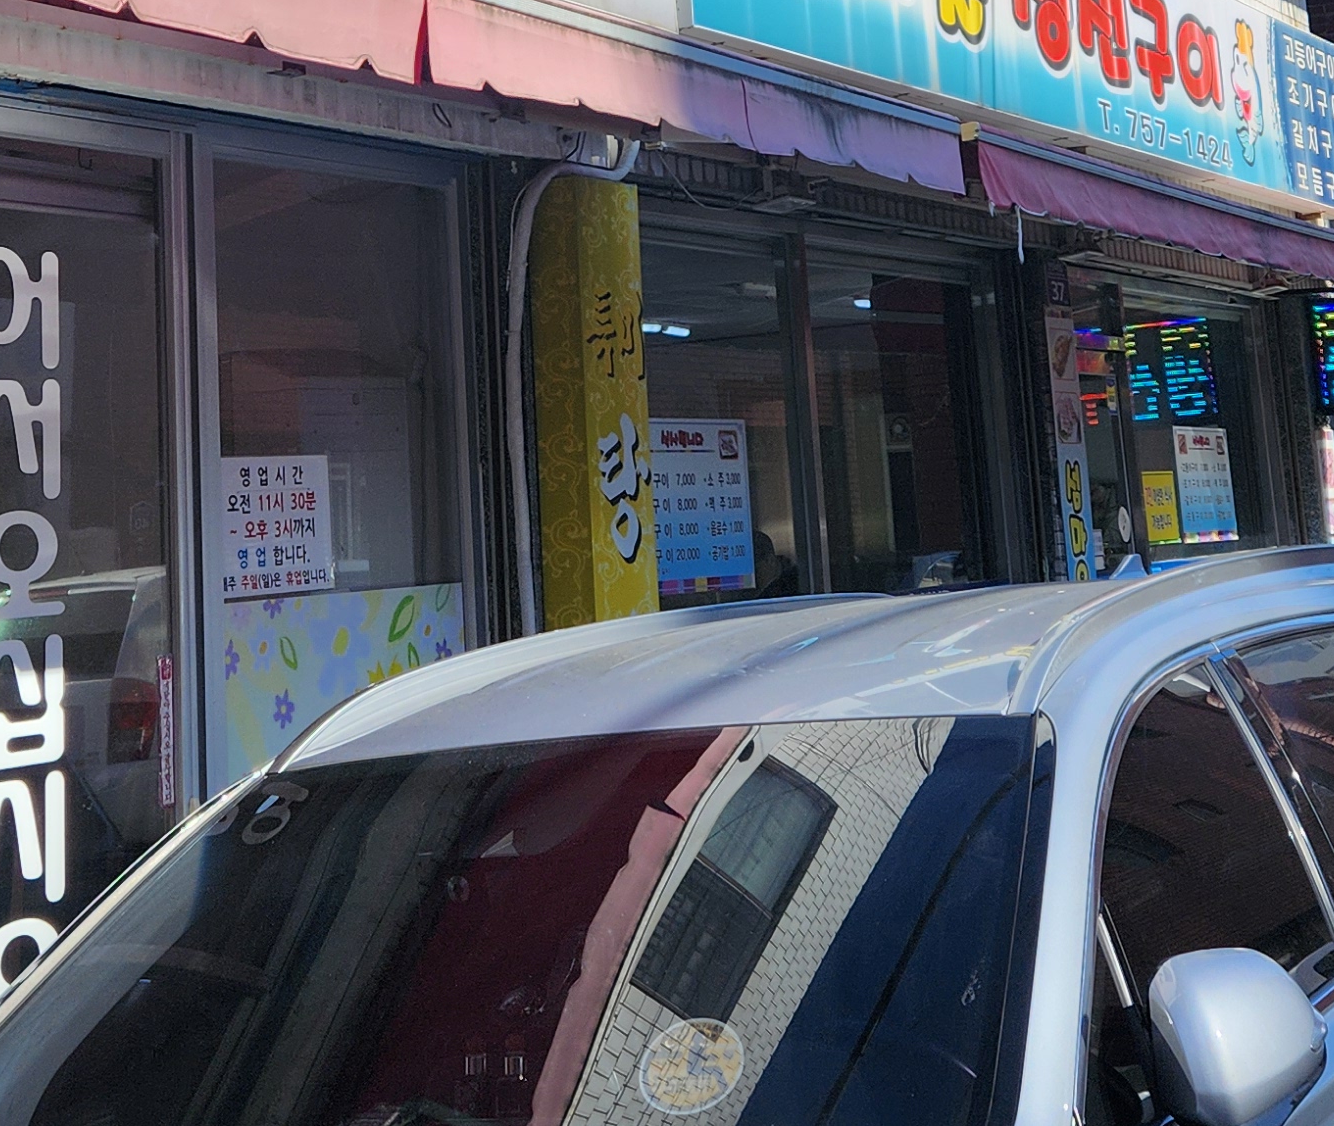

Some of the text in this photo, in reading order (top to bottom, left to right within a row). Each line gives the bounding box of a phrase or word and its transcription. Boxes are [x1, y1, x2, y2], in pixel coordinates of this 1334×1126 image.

[1050, 280, 1065, 302] 37
[239, 465, 304, 488] 영업시간
[226, 491, 317, 515] 오전 11시 30분
[244, 519, 269, 541] 오후
[274, 517, 316, 539] 3시까지
[272, 544, 311, 567] 합니다.
